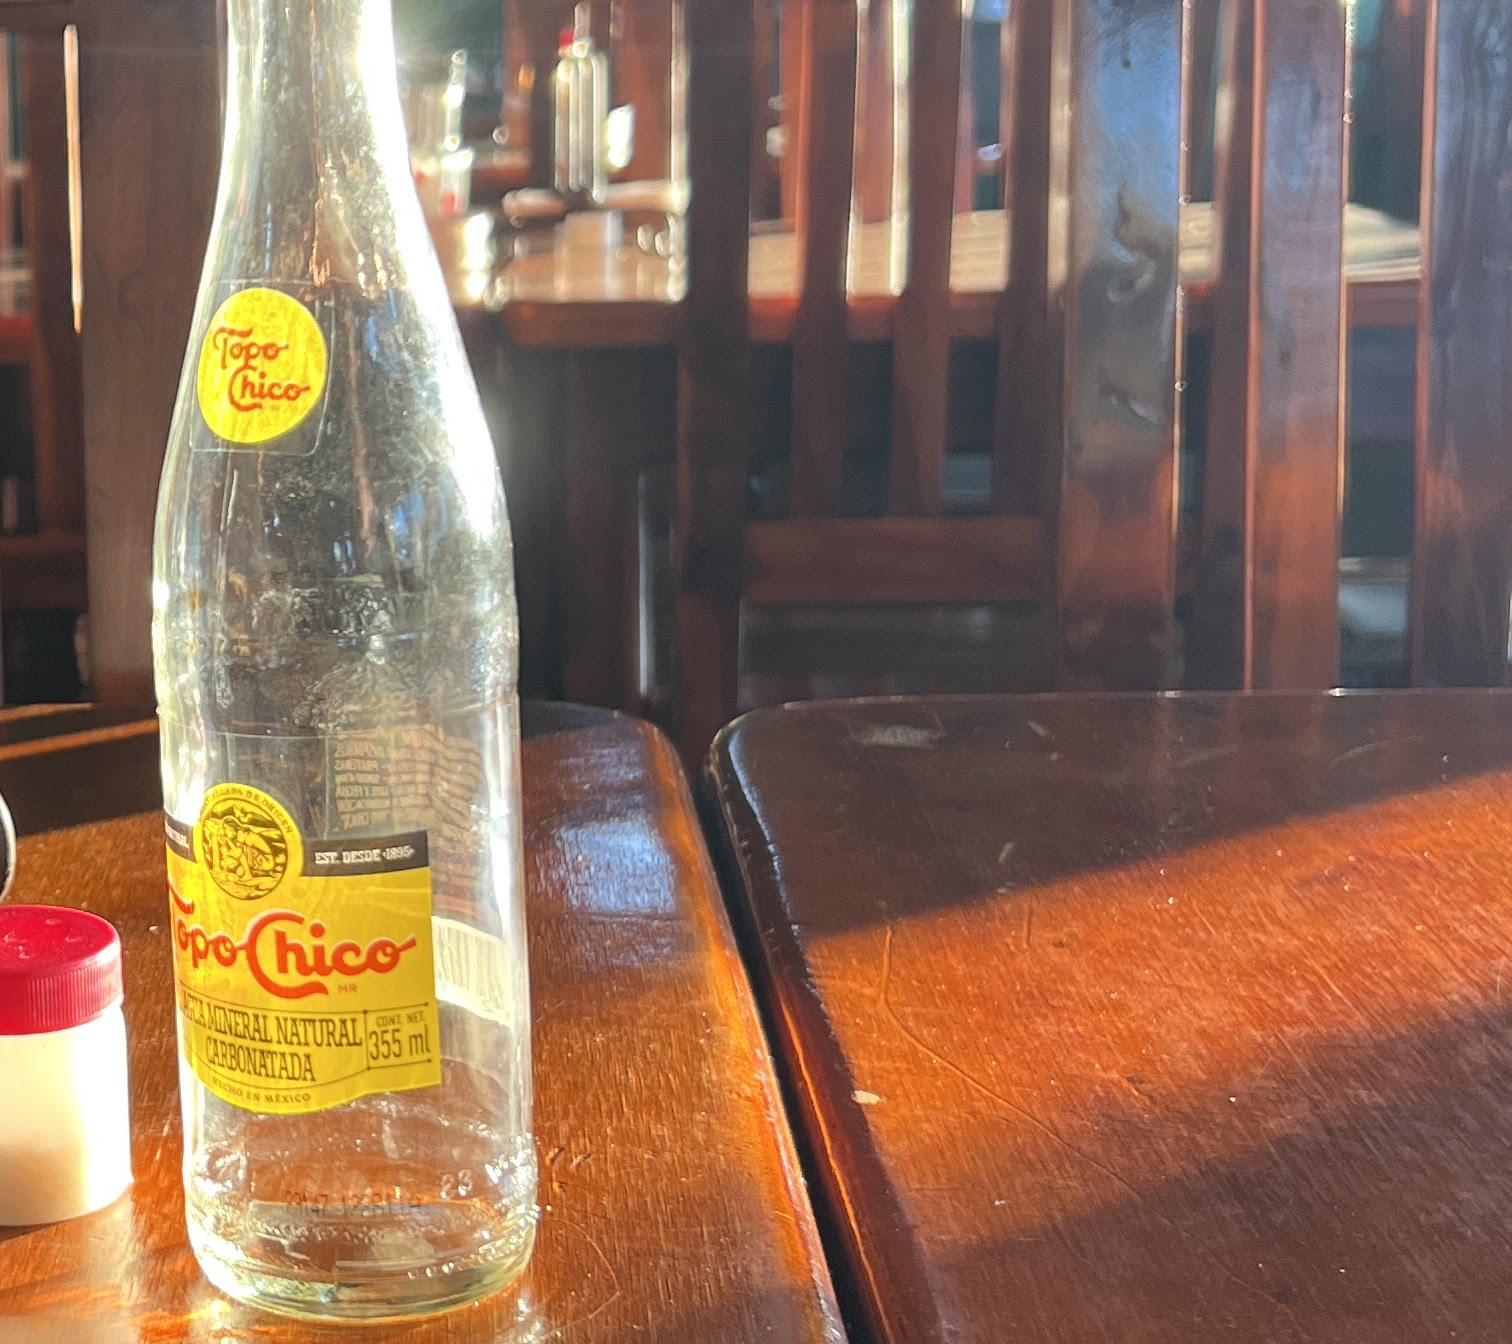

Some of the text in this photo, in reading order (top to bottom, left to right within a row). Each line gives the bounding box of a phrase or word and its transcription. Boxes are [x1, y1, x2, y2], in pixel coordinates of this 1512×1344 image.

[213, 326, 288, 370] Topo
[228, 365, 311, 412] Chico
[314, 851, 340, 865] EST.
[341, 848, 382, 864] DESDE
[245, 911, 417, 1000] Chico
[338, 982, 357, 994] MR
[206, 1002, 273, 1044] MINERAL
[274, 1016, 363, 1047] NATURAL
[369, 1023, 431, 1061] 355 ml
[205, 1036, 316, 1082] CARBONATADA
[212, 1075, 311, 1103] HECHO EN MÉXICO
